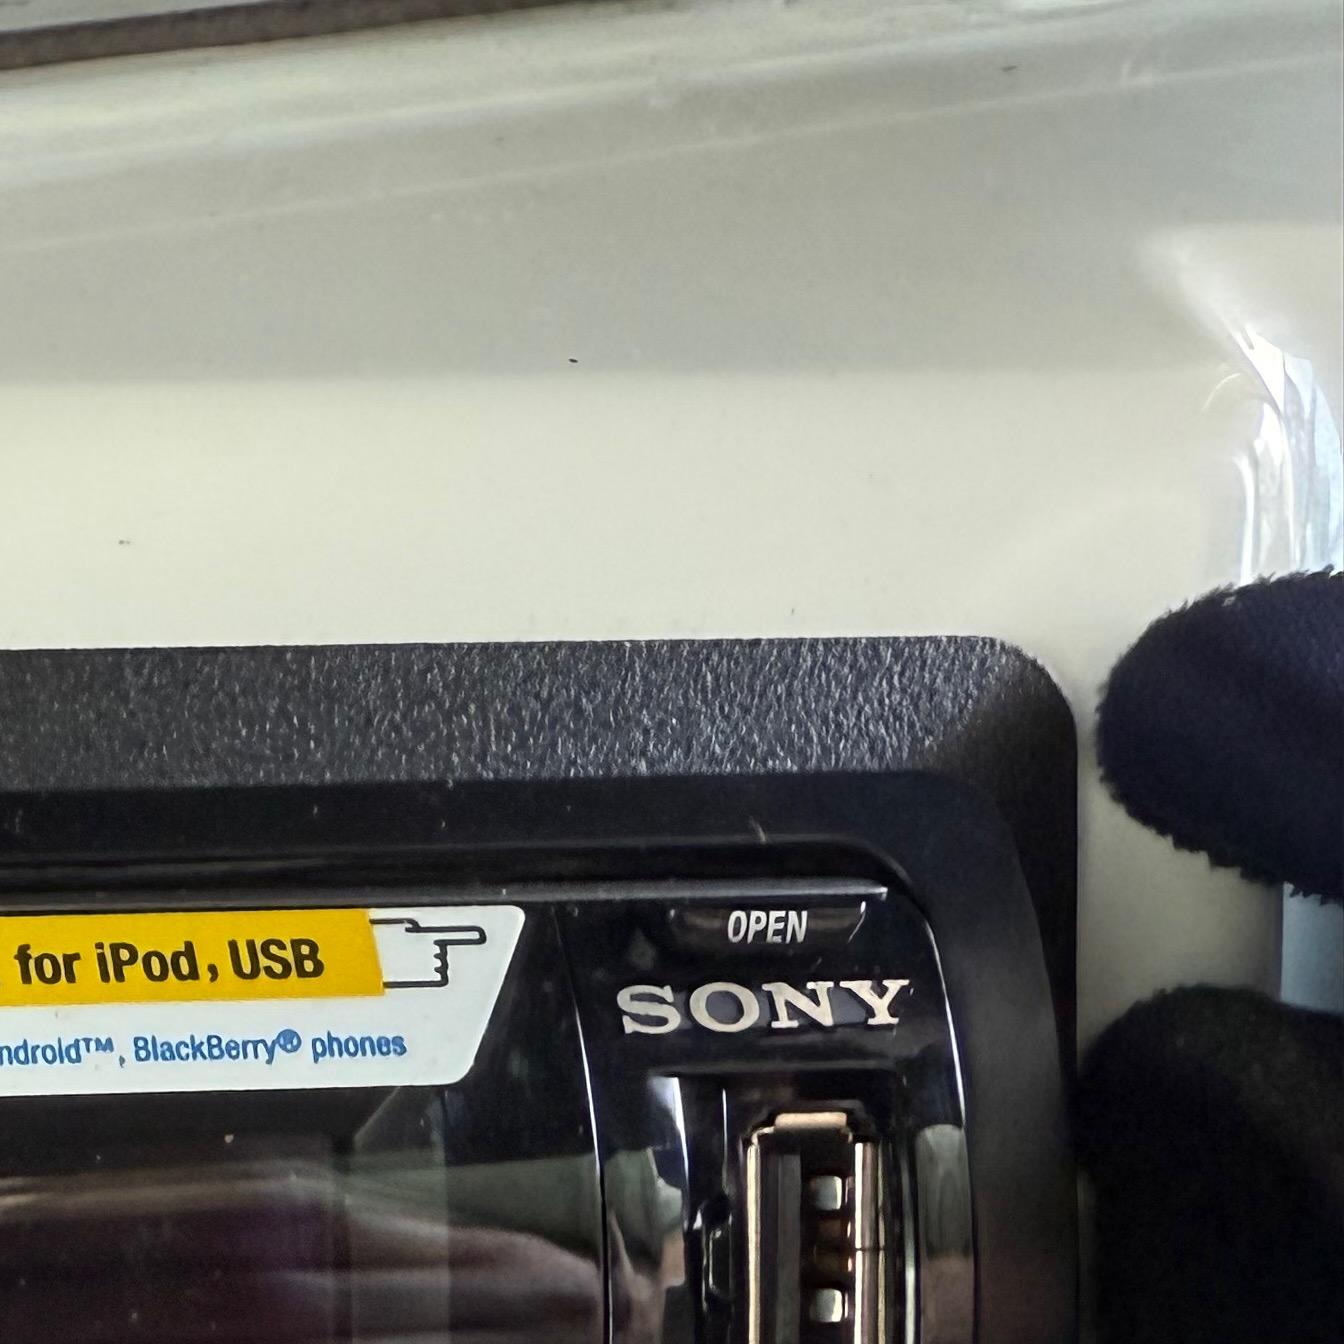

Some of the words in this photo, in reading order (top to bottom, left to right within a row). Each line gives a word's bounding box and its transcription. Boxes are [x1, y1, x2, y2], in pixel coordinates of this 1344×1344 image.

[727, 909, 809, 944] OPEN
[13, 943, 81, 985] for
[228, 937, 325, 980] USB
[616, 978, 910, 1035] SONY
[311, 1030, 408, 1065] phones
